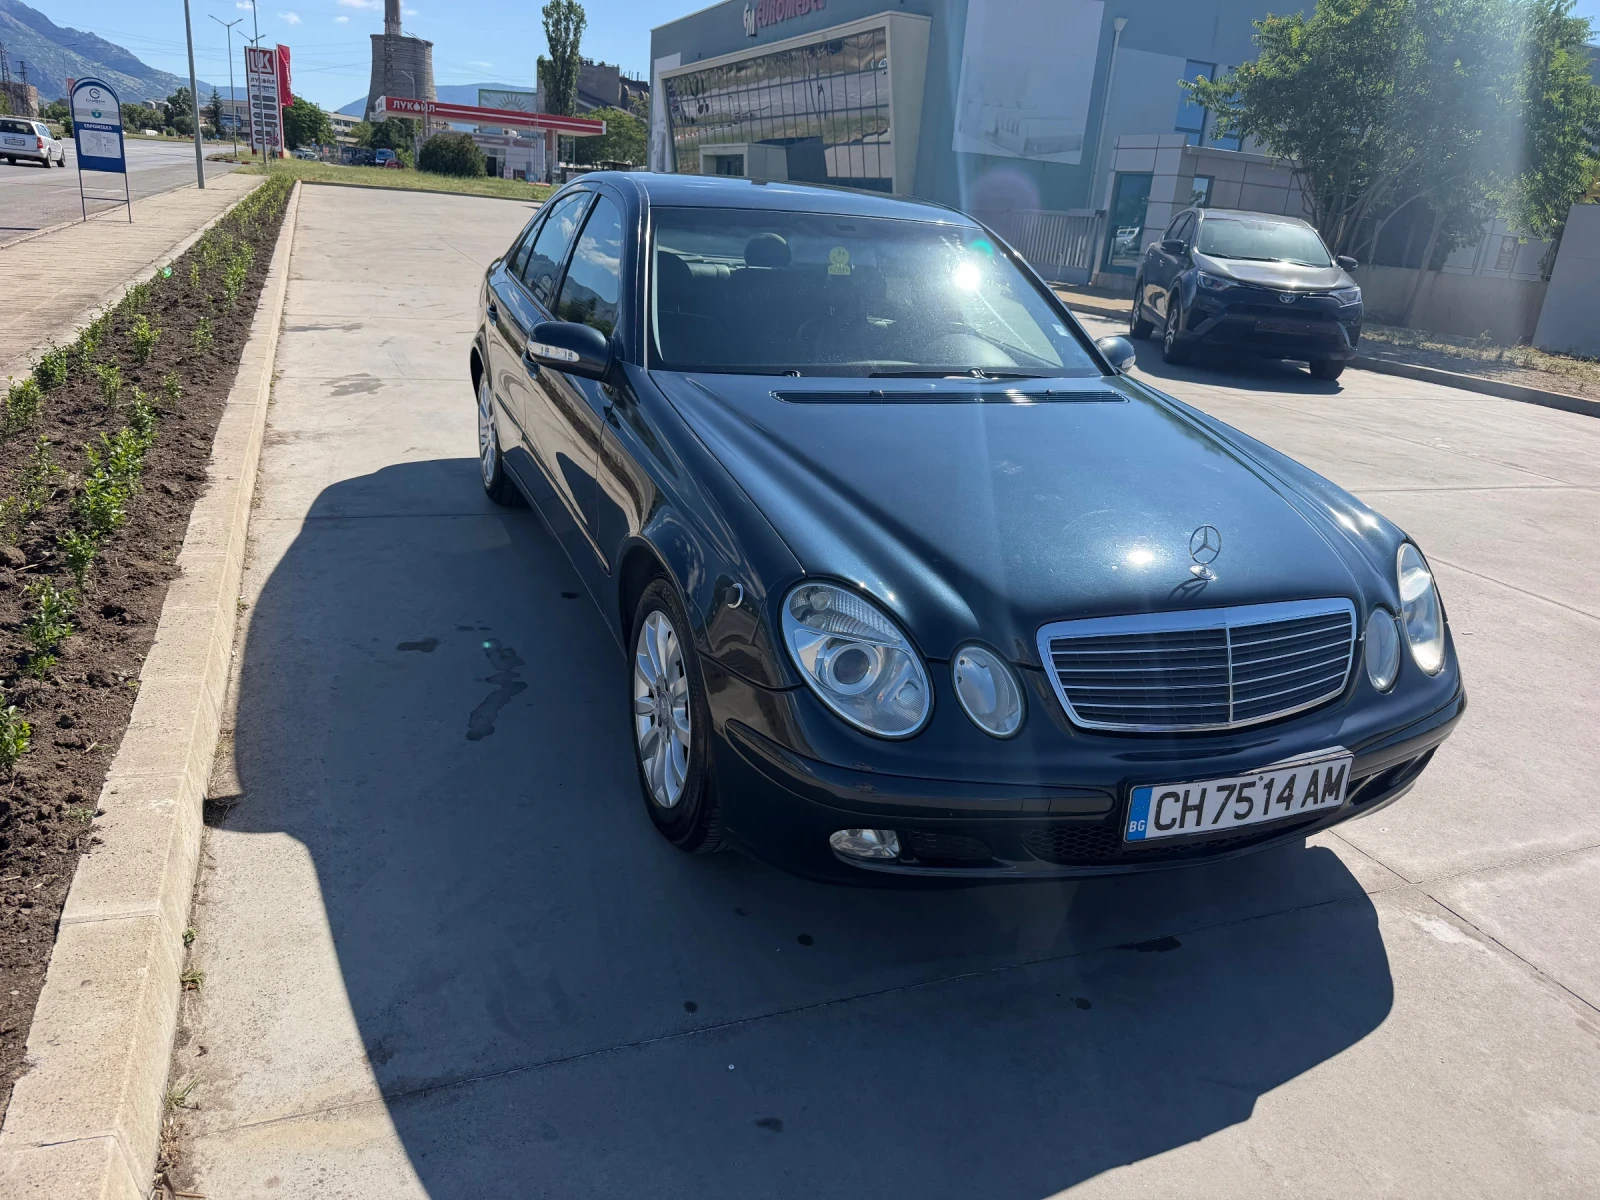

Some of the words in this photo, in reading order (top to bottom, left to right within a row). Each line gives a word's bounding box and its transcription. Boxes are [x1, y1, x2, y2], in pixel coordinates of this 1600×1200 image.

[392, 100, 435, 113] ЛУКОЙЛ
[1153, 787, 1208, 831] CH
[1211, 773, 1297, 825] 7514
[1300, 764, 1347, 809] AM
[1128, 820, 1146, 833] BG
